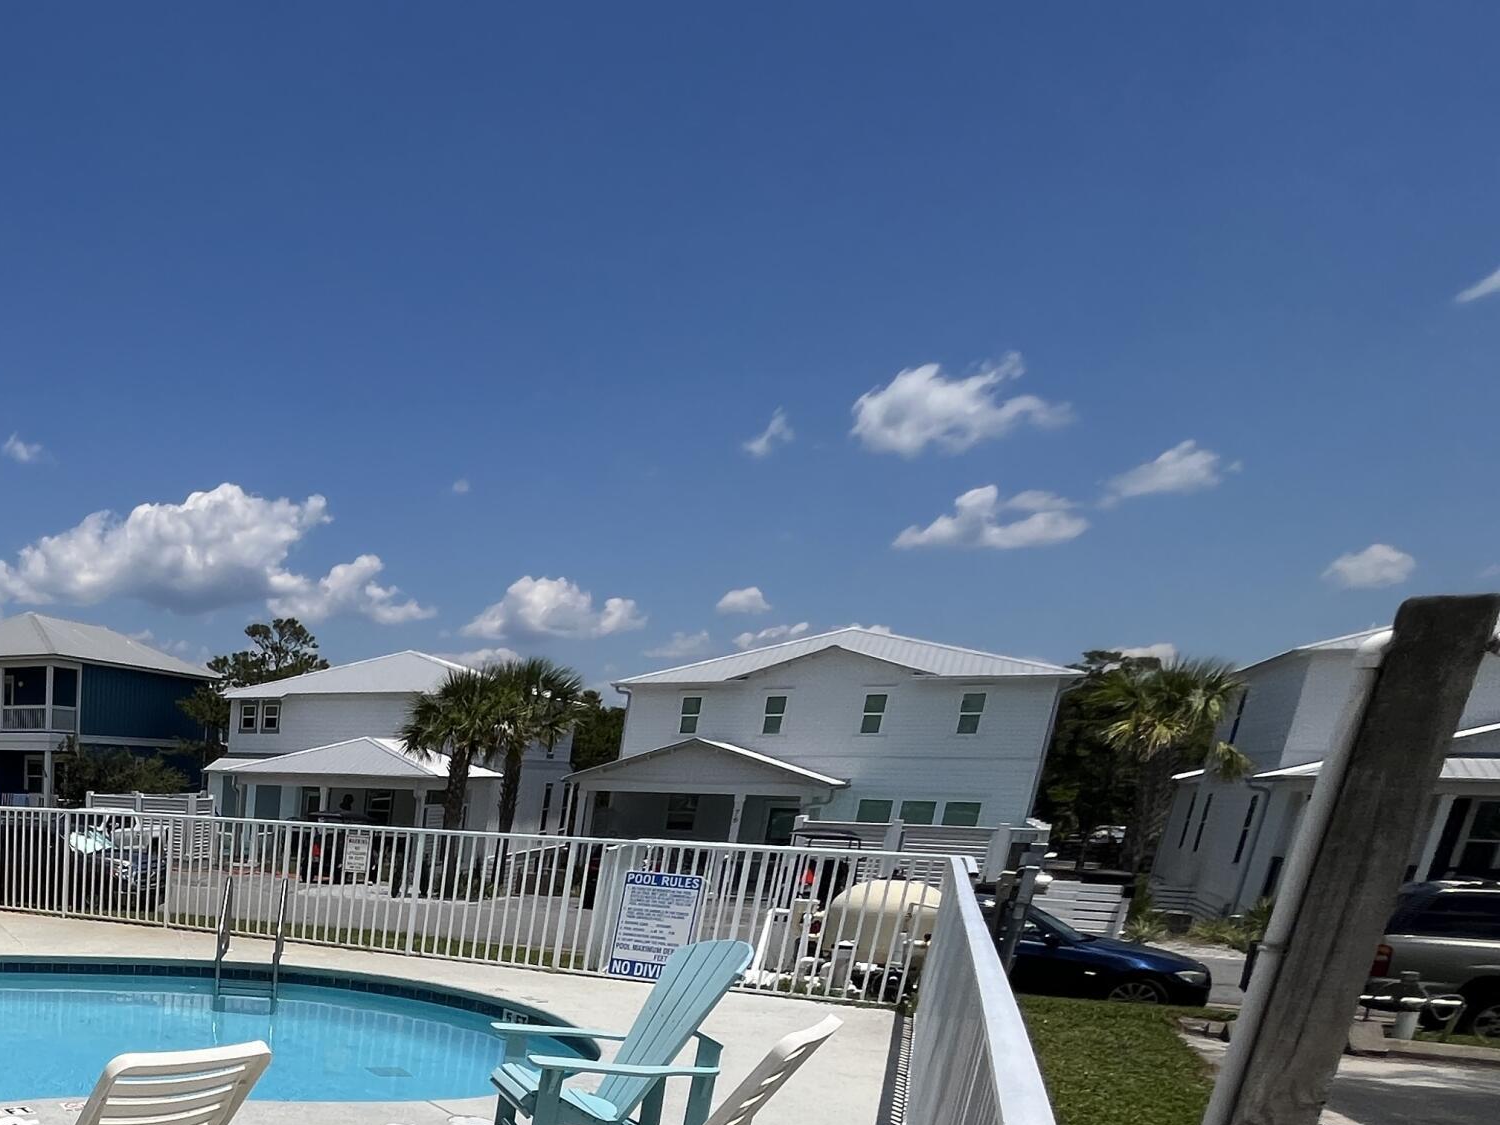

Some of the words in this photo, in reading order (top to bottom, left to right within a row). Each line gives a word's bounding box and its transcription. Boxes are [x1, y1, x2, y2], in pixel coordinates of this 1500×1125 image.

[627, 873, 657, 885] POOL
[661, 876, 700, 889] RULES
[612, 960, 630, 974] NO
[634, 963, 661, 978] DIVI
[4, 1106, 33, 1114] FT
